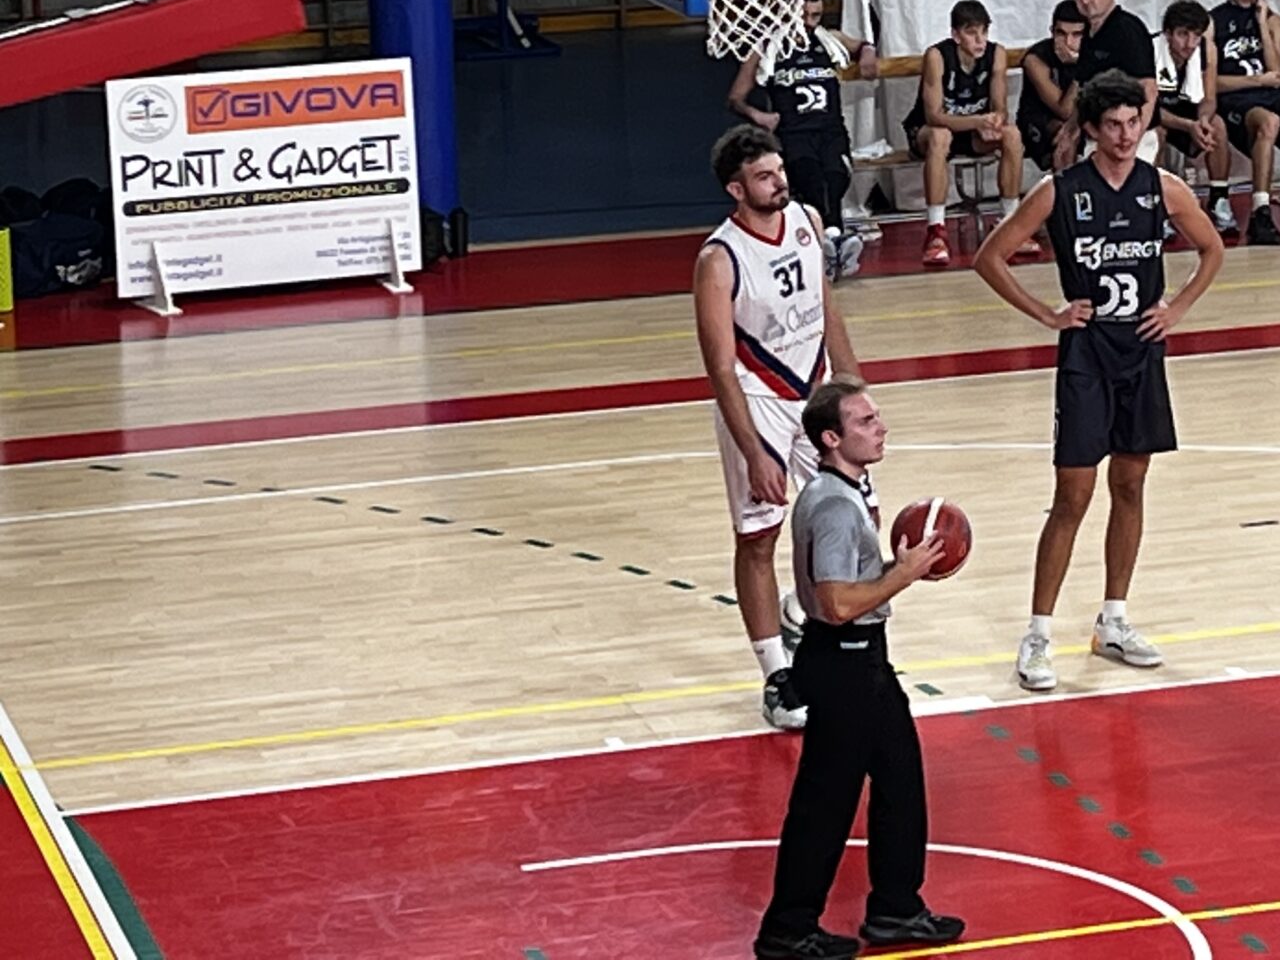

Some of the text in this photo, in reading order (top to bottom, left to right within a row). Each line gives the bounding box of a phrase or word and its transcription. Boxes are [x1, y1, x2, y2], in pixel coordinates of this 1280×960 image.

[229, 82, 399, 118] GIVOVA
[120, 148, 225, 192] PRINT
[232, 147, 261, 182] &
[267, 133, 400, 184] GADGET
[252, 181, 398, 205] PROMOZIONALE
[773, 258, 806, 298] 37
